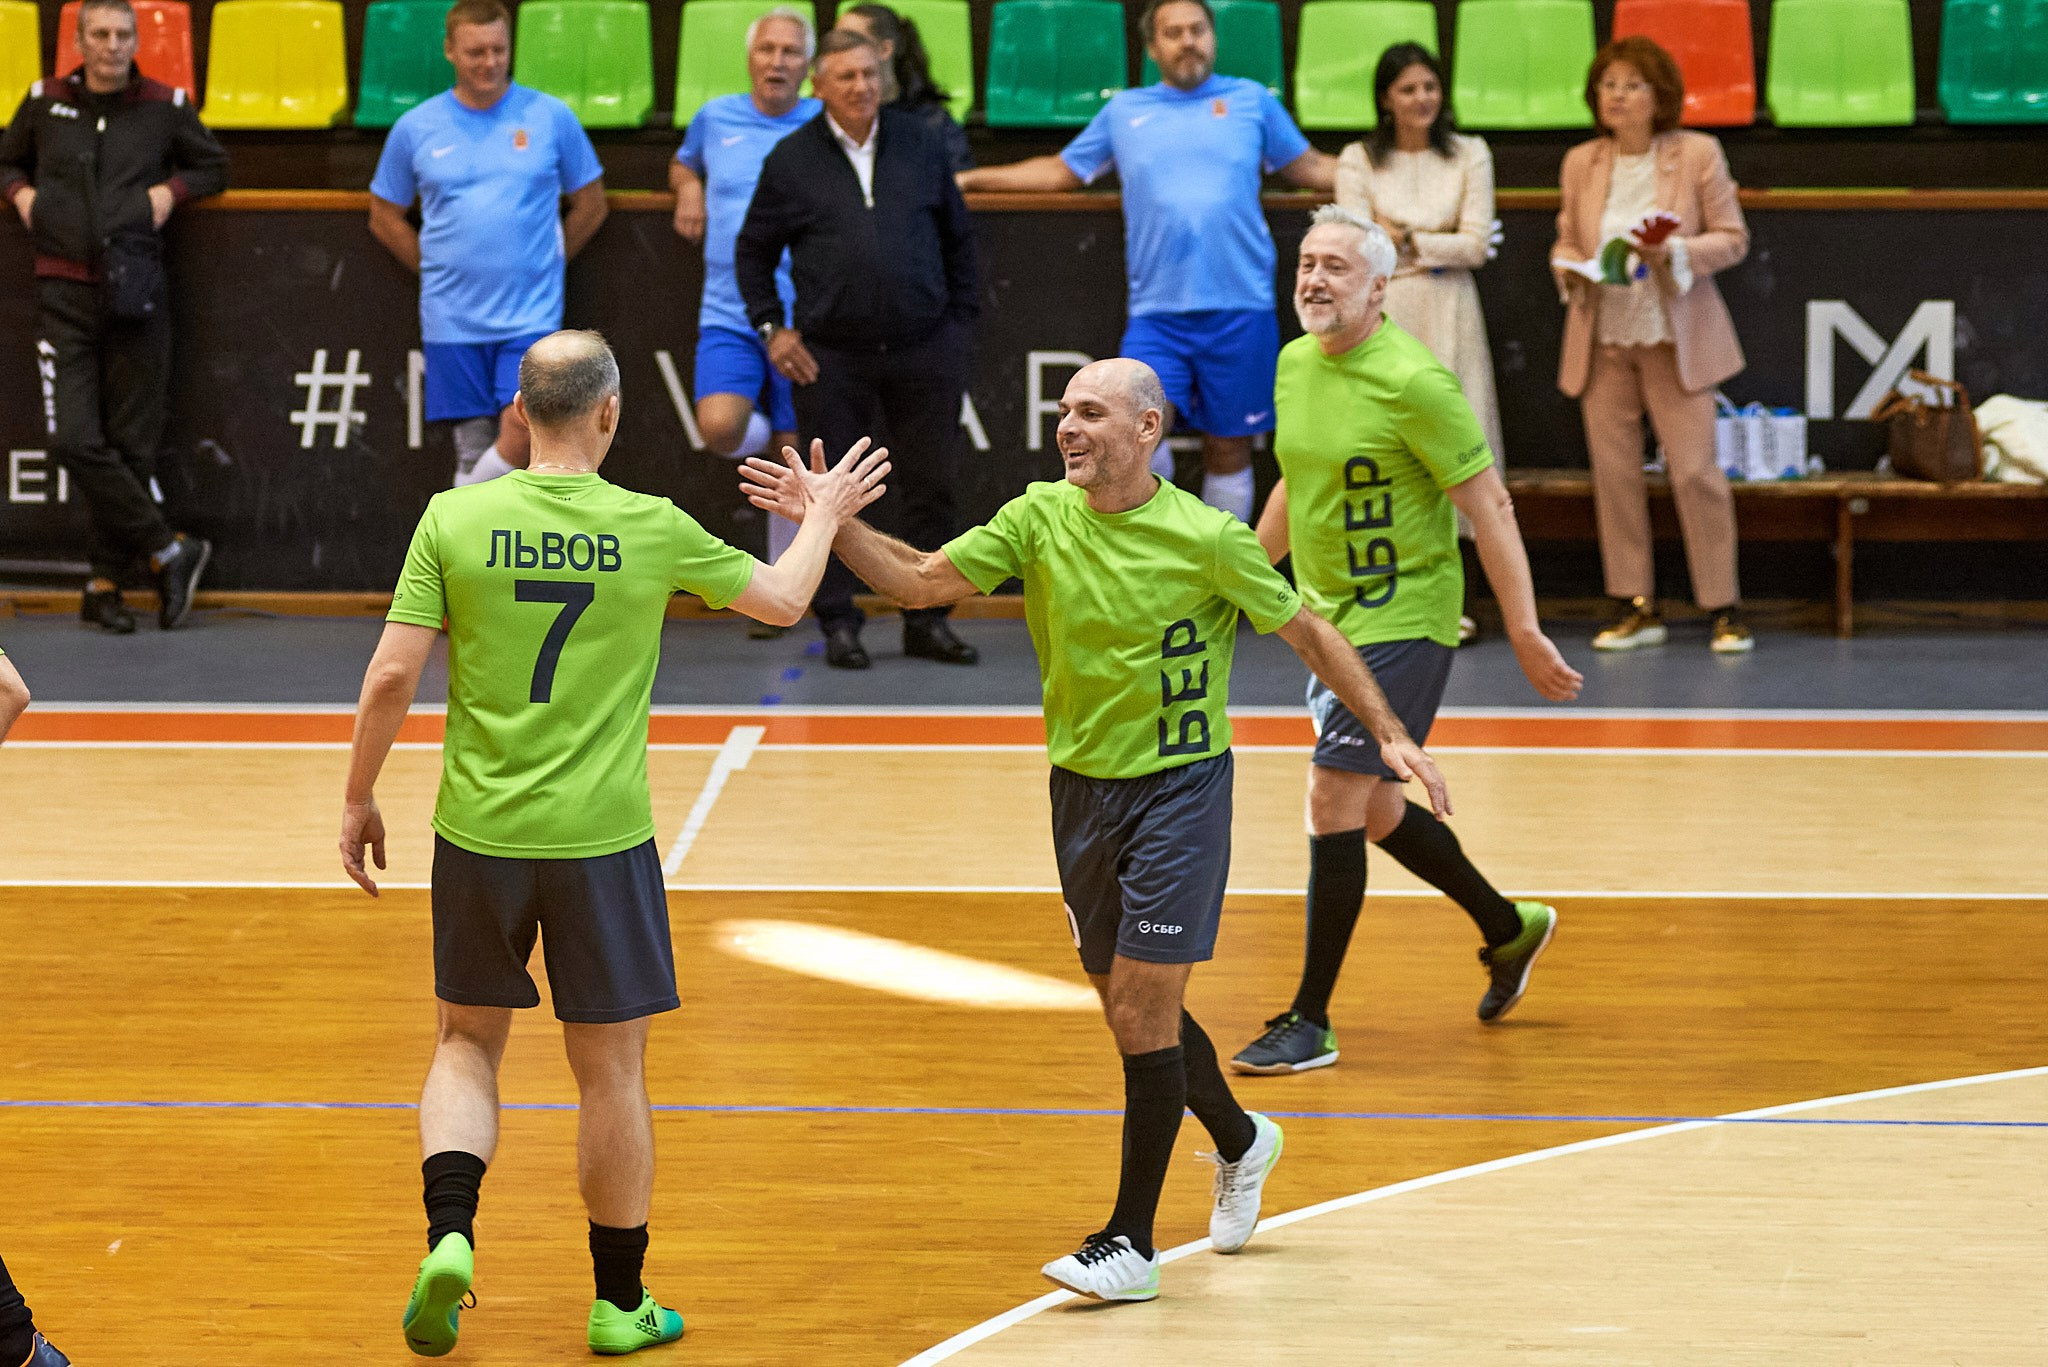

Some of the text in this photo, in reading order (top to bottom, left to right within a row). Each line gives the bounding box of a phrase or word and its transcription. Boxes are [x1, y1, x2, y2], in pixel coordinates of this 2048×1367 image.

[486, 530, 622, 572] ЛЬВОВ
[1345, 456, 1397, 608] СБЕР
[515, 580, 595, 703] 7
[1153, 924, 1183, 934] СБЕР
